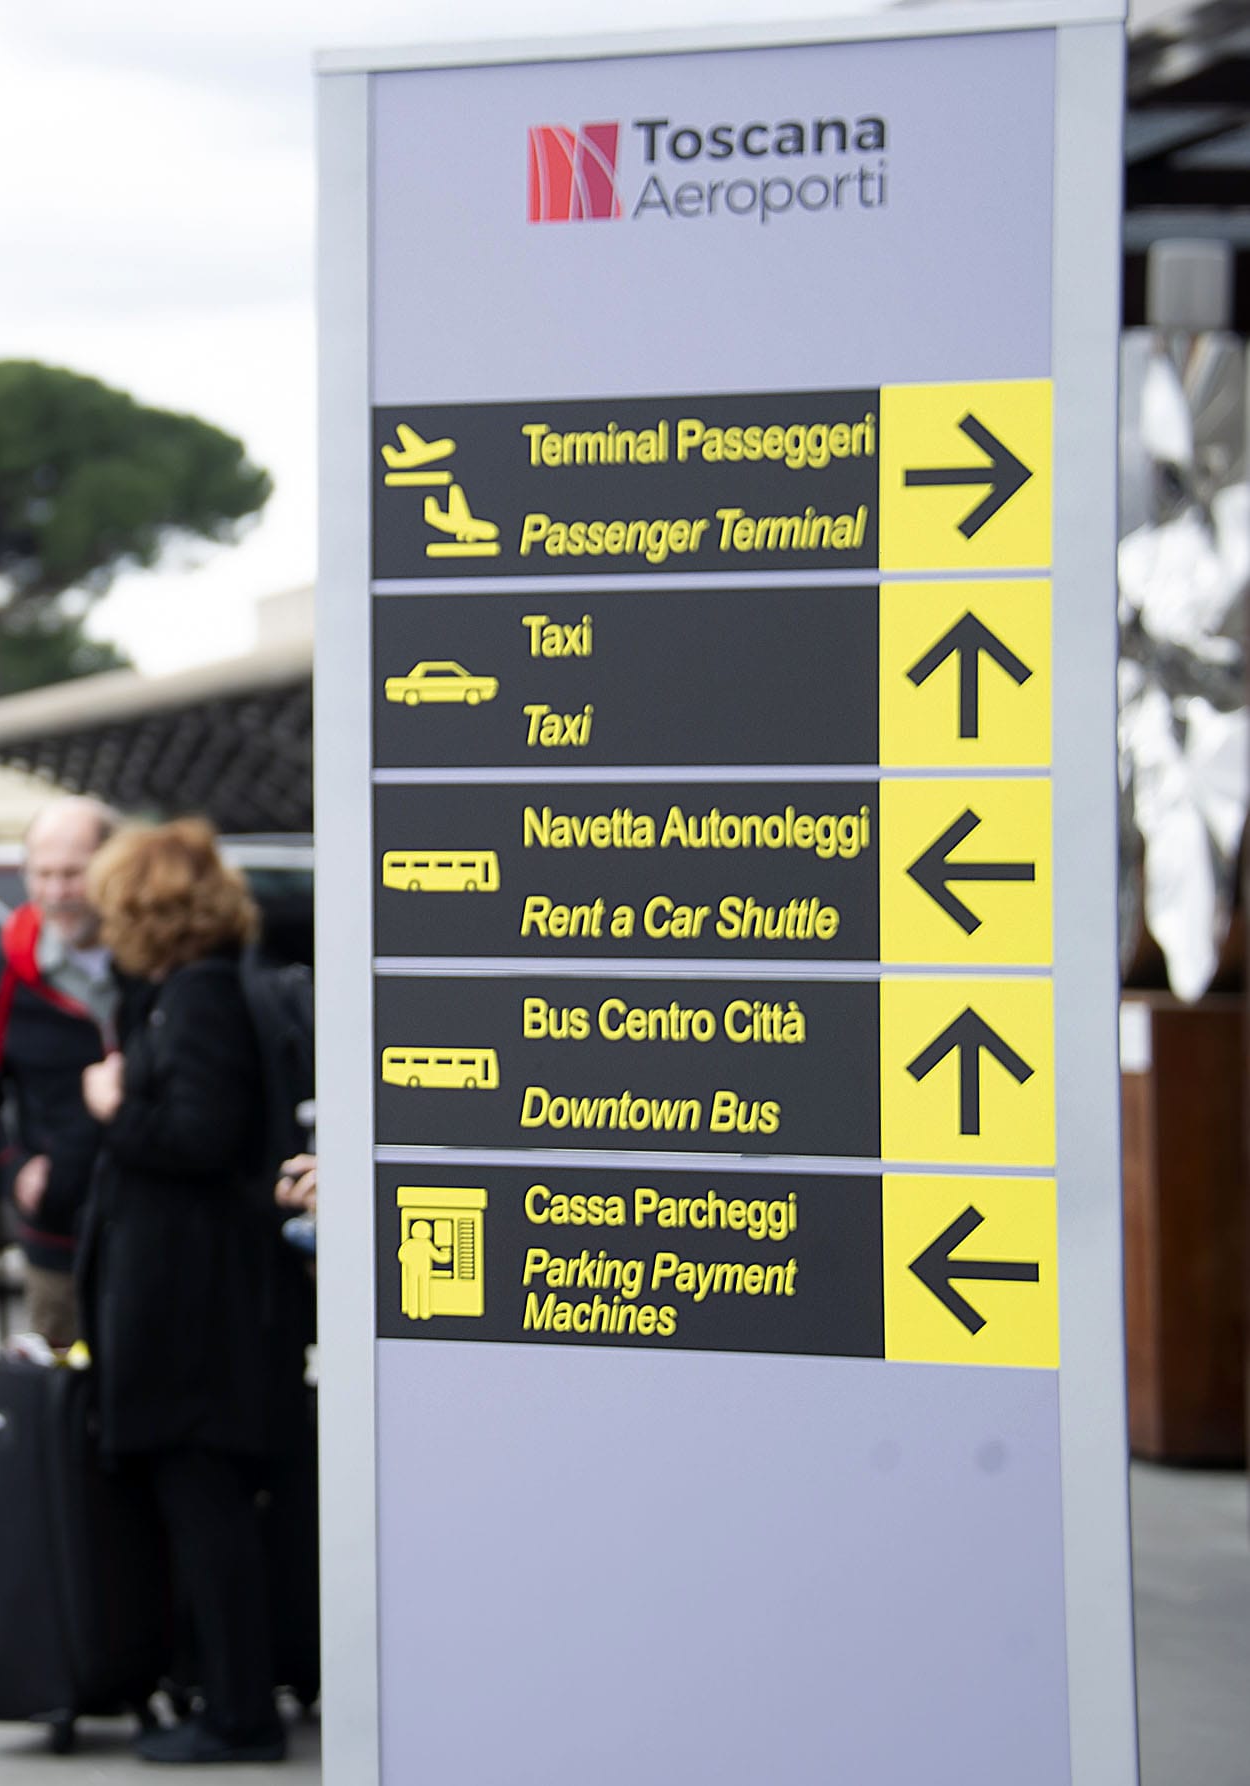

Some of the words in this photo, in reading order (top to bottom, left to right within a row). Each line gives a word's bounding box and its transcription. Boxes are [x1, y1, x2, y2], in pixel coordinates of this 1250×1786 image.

[633, 114, 887, 163] Toscana
[633, 161, 887, 223] Aeroporti
[522, 421, 668, 466] Terminal
[677, 413, 875, 469] Passeggeri
[520, 514, 708, 563] Passenger
[716, 506, 867, 551] Terminal
[522, 615, 592, 657] Taxi
[523, 705, 592, 747] Taxi
[524, 807, 655, 848] Navetta
[660, 806, 870, 859] Autonoleggi
[521, 896, 604, 938] Rent
[610, 906, 634, 938] a
[644, 896, 710, 938] Car
[716, 896, 839, 940] Shuttle
[523, 998, 590, 1040] Bus
[598, 998, 716, 1042] Centro
[724, 1000, 805, 1043] Città
[520, 1087, 701, 1131] Downtown
[710, 1091, 780, 1134] Bus
[525, 1185, 626, 1226] Cassa
[635, 1188, 797, 1240] Parcheggi
[523, 1248, 644, 1298] Parking
[650, 1252, 797, 1301] Payment
[523, 1293, 677, 1336] Machines
